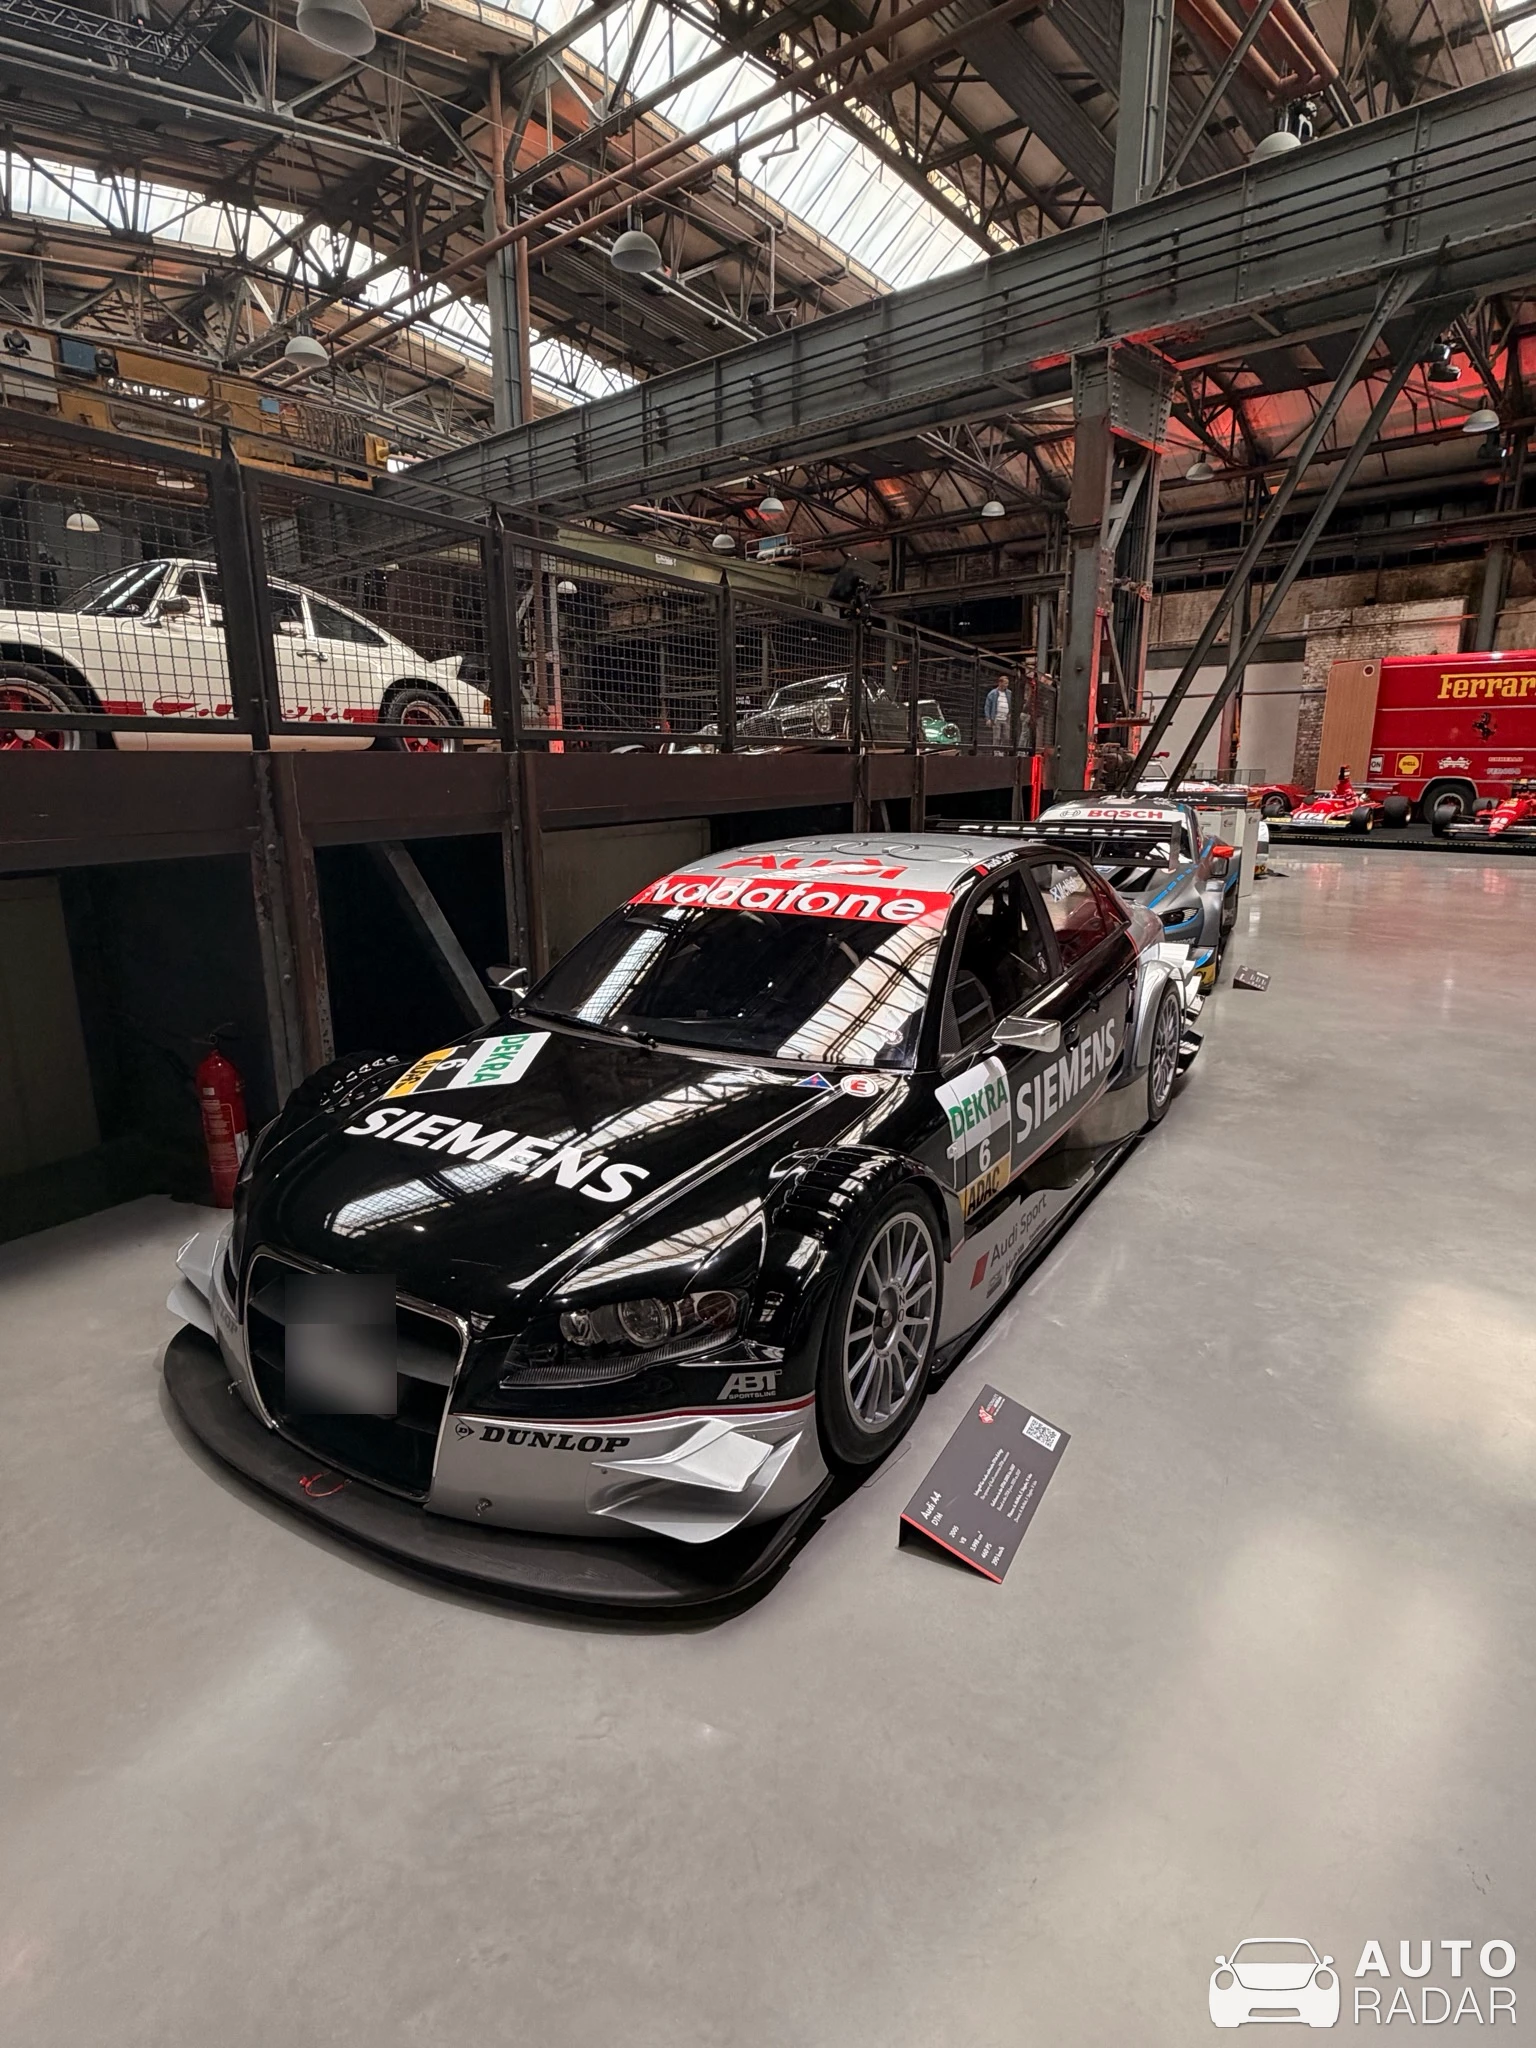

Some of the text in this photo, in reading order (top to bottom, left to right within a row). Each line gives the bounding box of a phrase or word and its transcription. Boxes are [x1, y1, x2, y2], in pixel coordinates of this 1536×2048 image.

[1437, 671, 1536, 699] Ferrar
[1087, 809, 1163, 820] BOSCH
[651, 877, 926, 922] vodafone
[435, 1058, 468, 1071] 6
[467, 1034, 530, 1085] DEKRA
[1016, 1018, 1115, 1144] SIEMENS
[948, 1077, 1009, 1140] DEKRA
[343, 1107, 650, 1203] SIEMENS
[978, 1138, 991, 1172] 6
[967, 1166, 1000, 1217] ADAC
[990, 1223, 1018, 1268] Audi
[1020, 1194, 1047, 1235] Sport
[716, 1369, 783, 1401] ABT
[479, 1425, 631, 1453] DUNLOP
[921, 1490, 942, 1520] Audi A4
[931, 1512, 944, 1526] DTM
